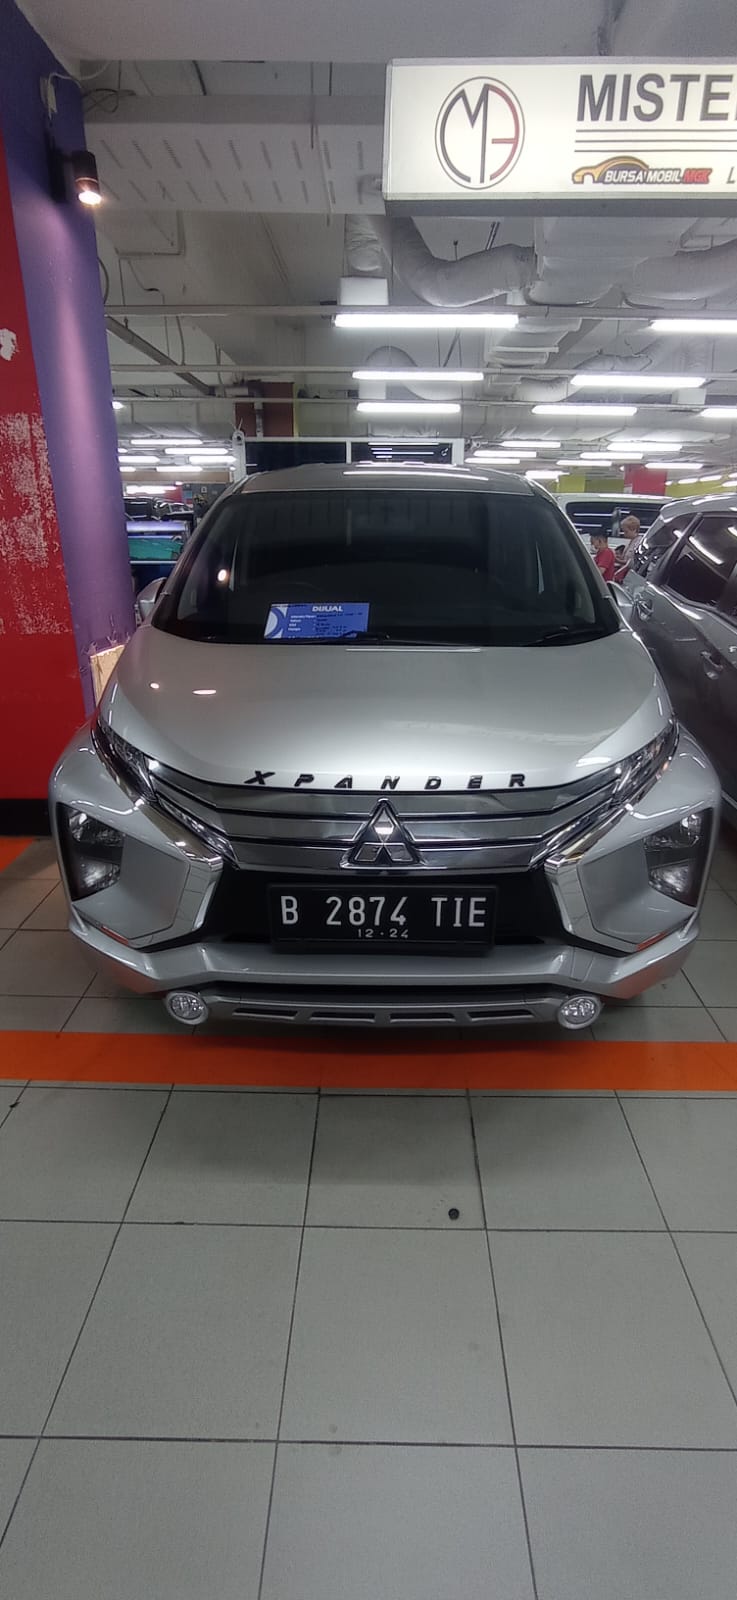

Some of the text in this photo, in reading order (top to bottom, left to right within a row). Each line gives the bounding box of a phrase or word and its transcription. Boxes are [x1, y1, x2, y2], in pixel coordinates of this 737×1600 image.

[577, 73, 737, 122] MISTE
[604, 170, 644, 183] BURSA
[645, 169, 681, 183] MOBIL
[682, 168, 712, 184] MGK
[244, 770, 525, 790] XPANDER
[281, 895, 487, 927] B 2874 TIE
